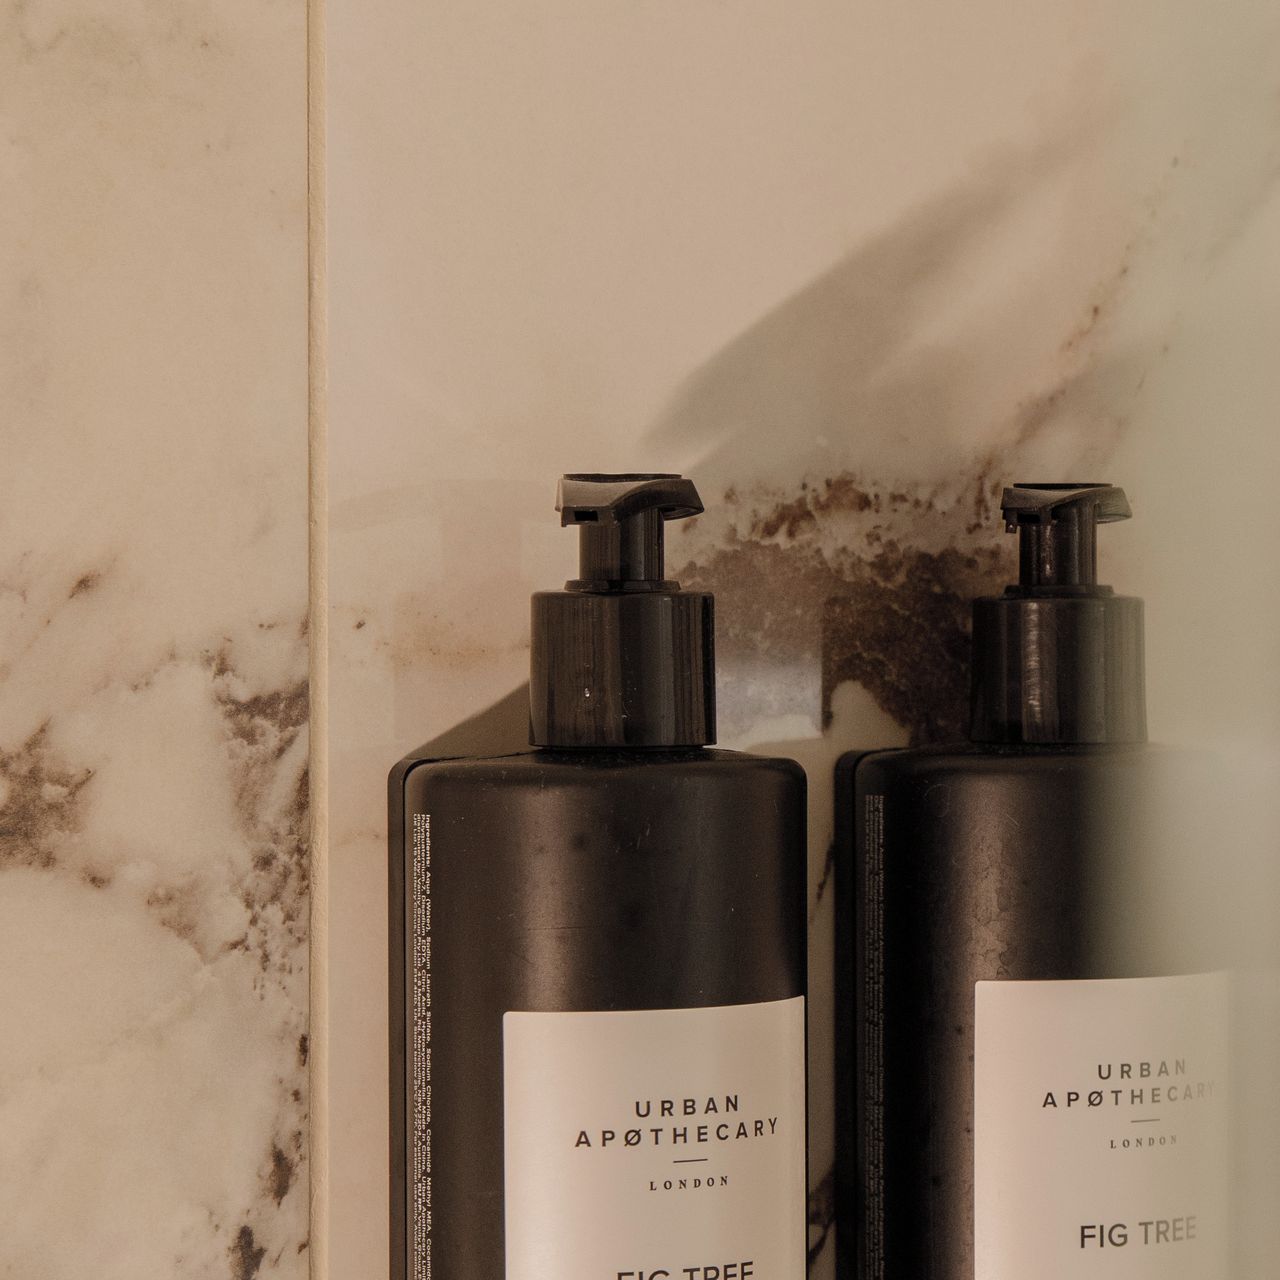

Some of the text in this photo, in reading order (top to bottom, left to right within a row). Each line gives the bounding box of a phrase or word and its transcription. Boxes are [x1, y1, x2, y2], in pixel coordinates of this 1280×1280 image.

[1097, 1058, 1185, 1081] URBAN
[635, 1095, 740, 1119] URBAN
[574, 1117, 779, 1148] APØTHECARY
[1110, 1134, 1177, 1150] LONDON
[649, 1175, 729, 1192] LONDON
[1079, 1216, 1198, 1249] FIG TREE
